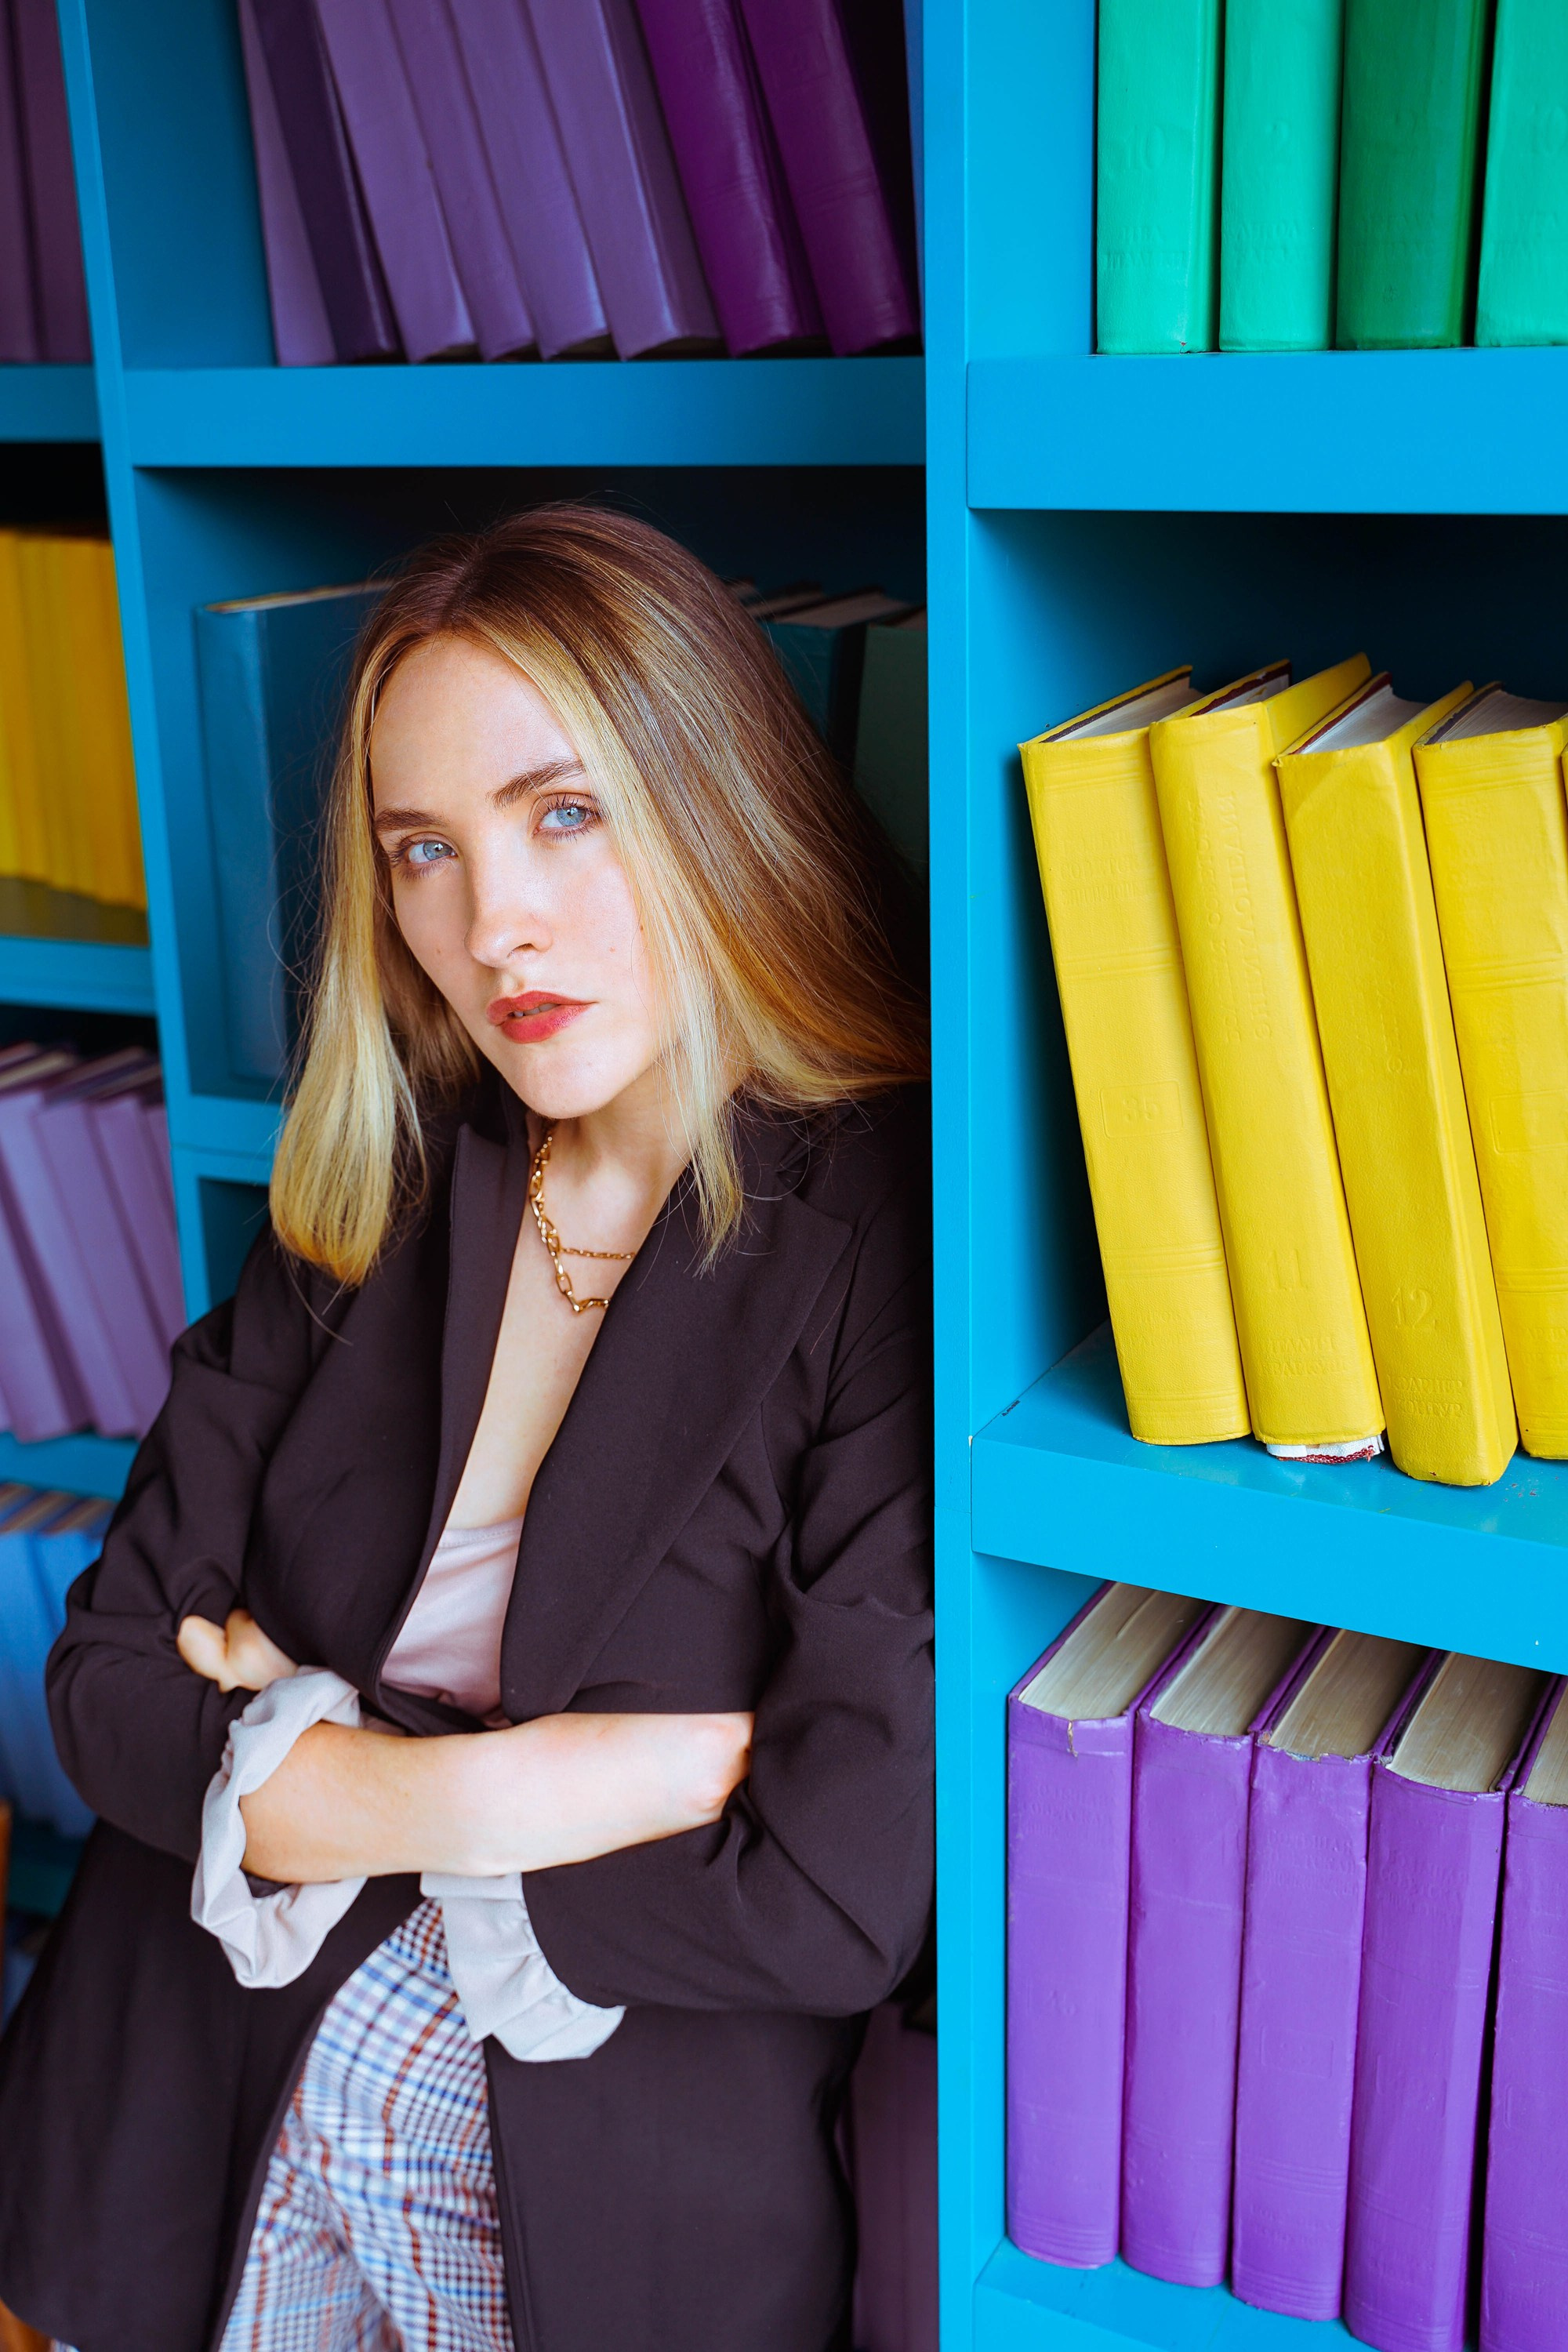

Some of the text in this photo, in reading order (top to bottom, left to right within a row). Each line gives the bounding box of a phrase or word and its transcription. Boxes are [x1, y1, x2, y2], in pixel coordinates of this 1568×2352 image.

[1217, 790, 1272, 1041] ЭНЦИКЛОПЕДИЯ
[1262, 1247, 1310, 1293] 11
[1390, 1286, 1439, 1330] 12
